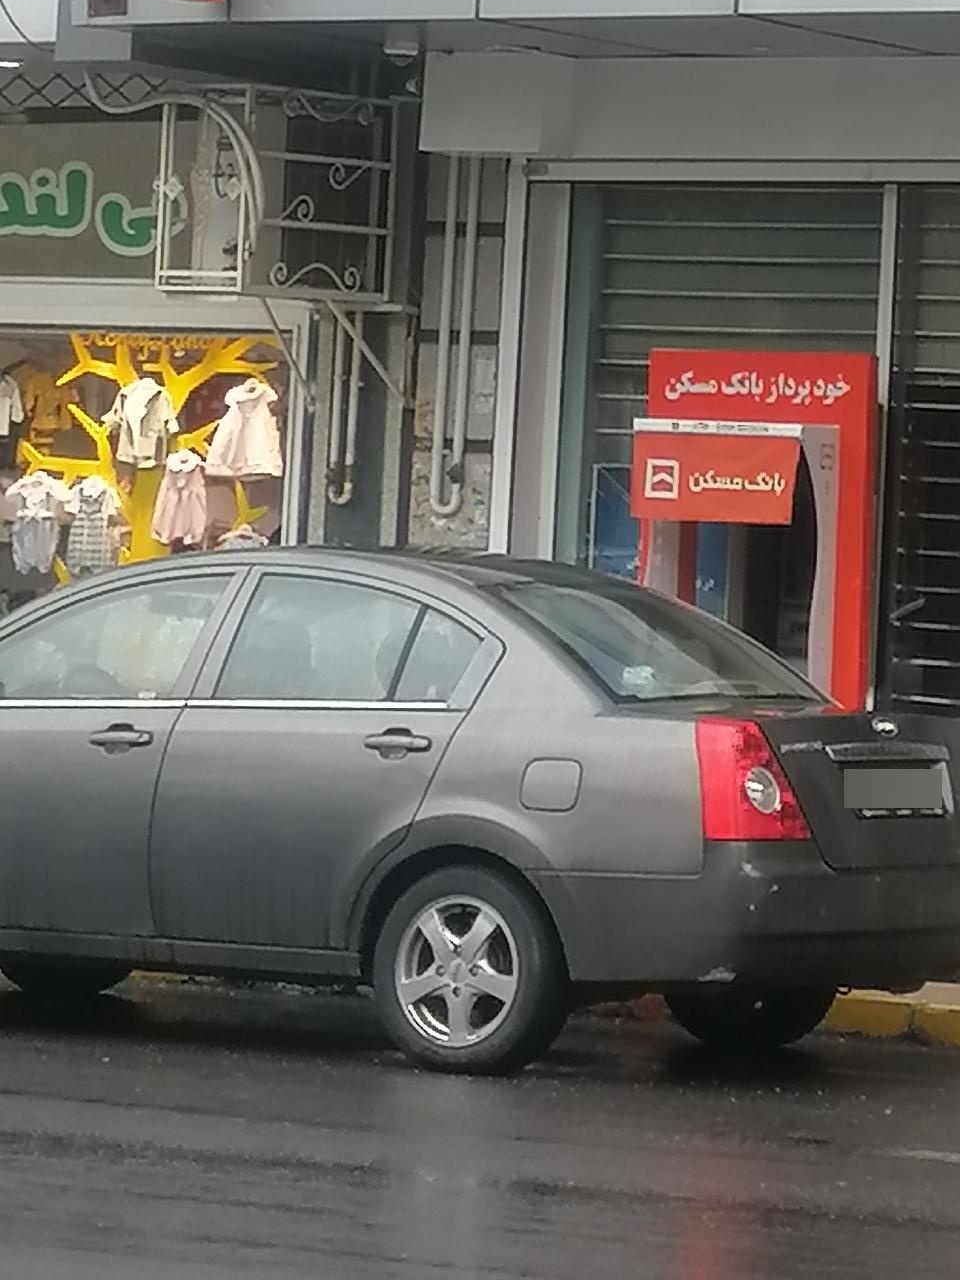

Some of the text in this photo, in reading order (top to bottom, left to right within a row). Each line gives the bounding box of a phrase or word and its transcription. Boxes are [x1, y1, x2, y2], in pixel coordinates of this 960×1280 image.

[664, 370, 718, 400] مسکن
[721, 370, 763, 402] بانک
[688, 470, 786, 496] بانک مسکن
